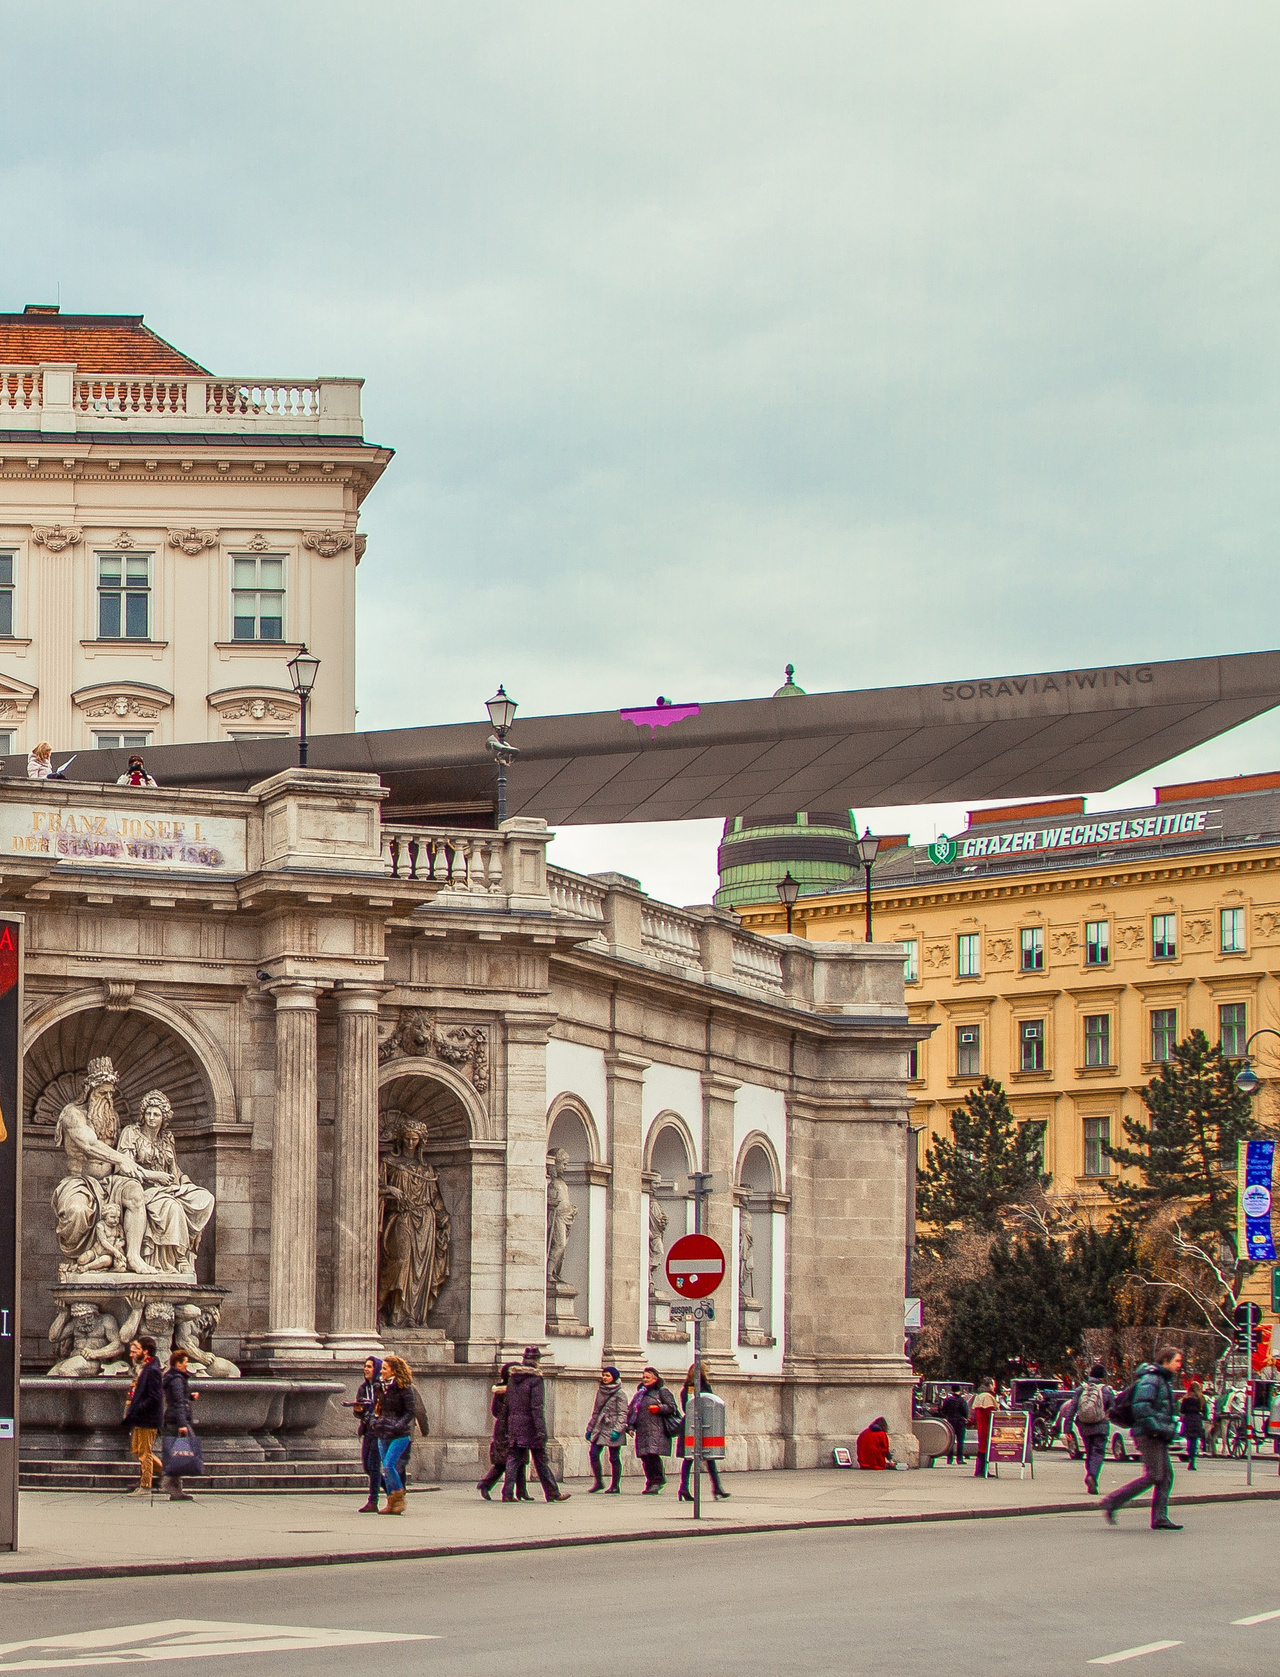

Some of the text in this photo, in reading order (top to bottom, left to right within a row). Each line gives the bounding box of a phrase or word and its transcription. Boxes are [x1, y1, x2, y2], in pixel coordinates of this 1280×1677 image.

[941, 667, 1154, 701] SORAVIA WING
[32, 811, 206, 841] FRANZ JOSEF I.
[962, 811, 1209, 858] GRAZER WECHSELSEITIGE
[11, 836, 50, 852] DER
[58, 840, 119, 857] STADT
[126, 843, 173, 860] WIEN
[0, 1309, 11, 1337] I.
